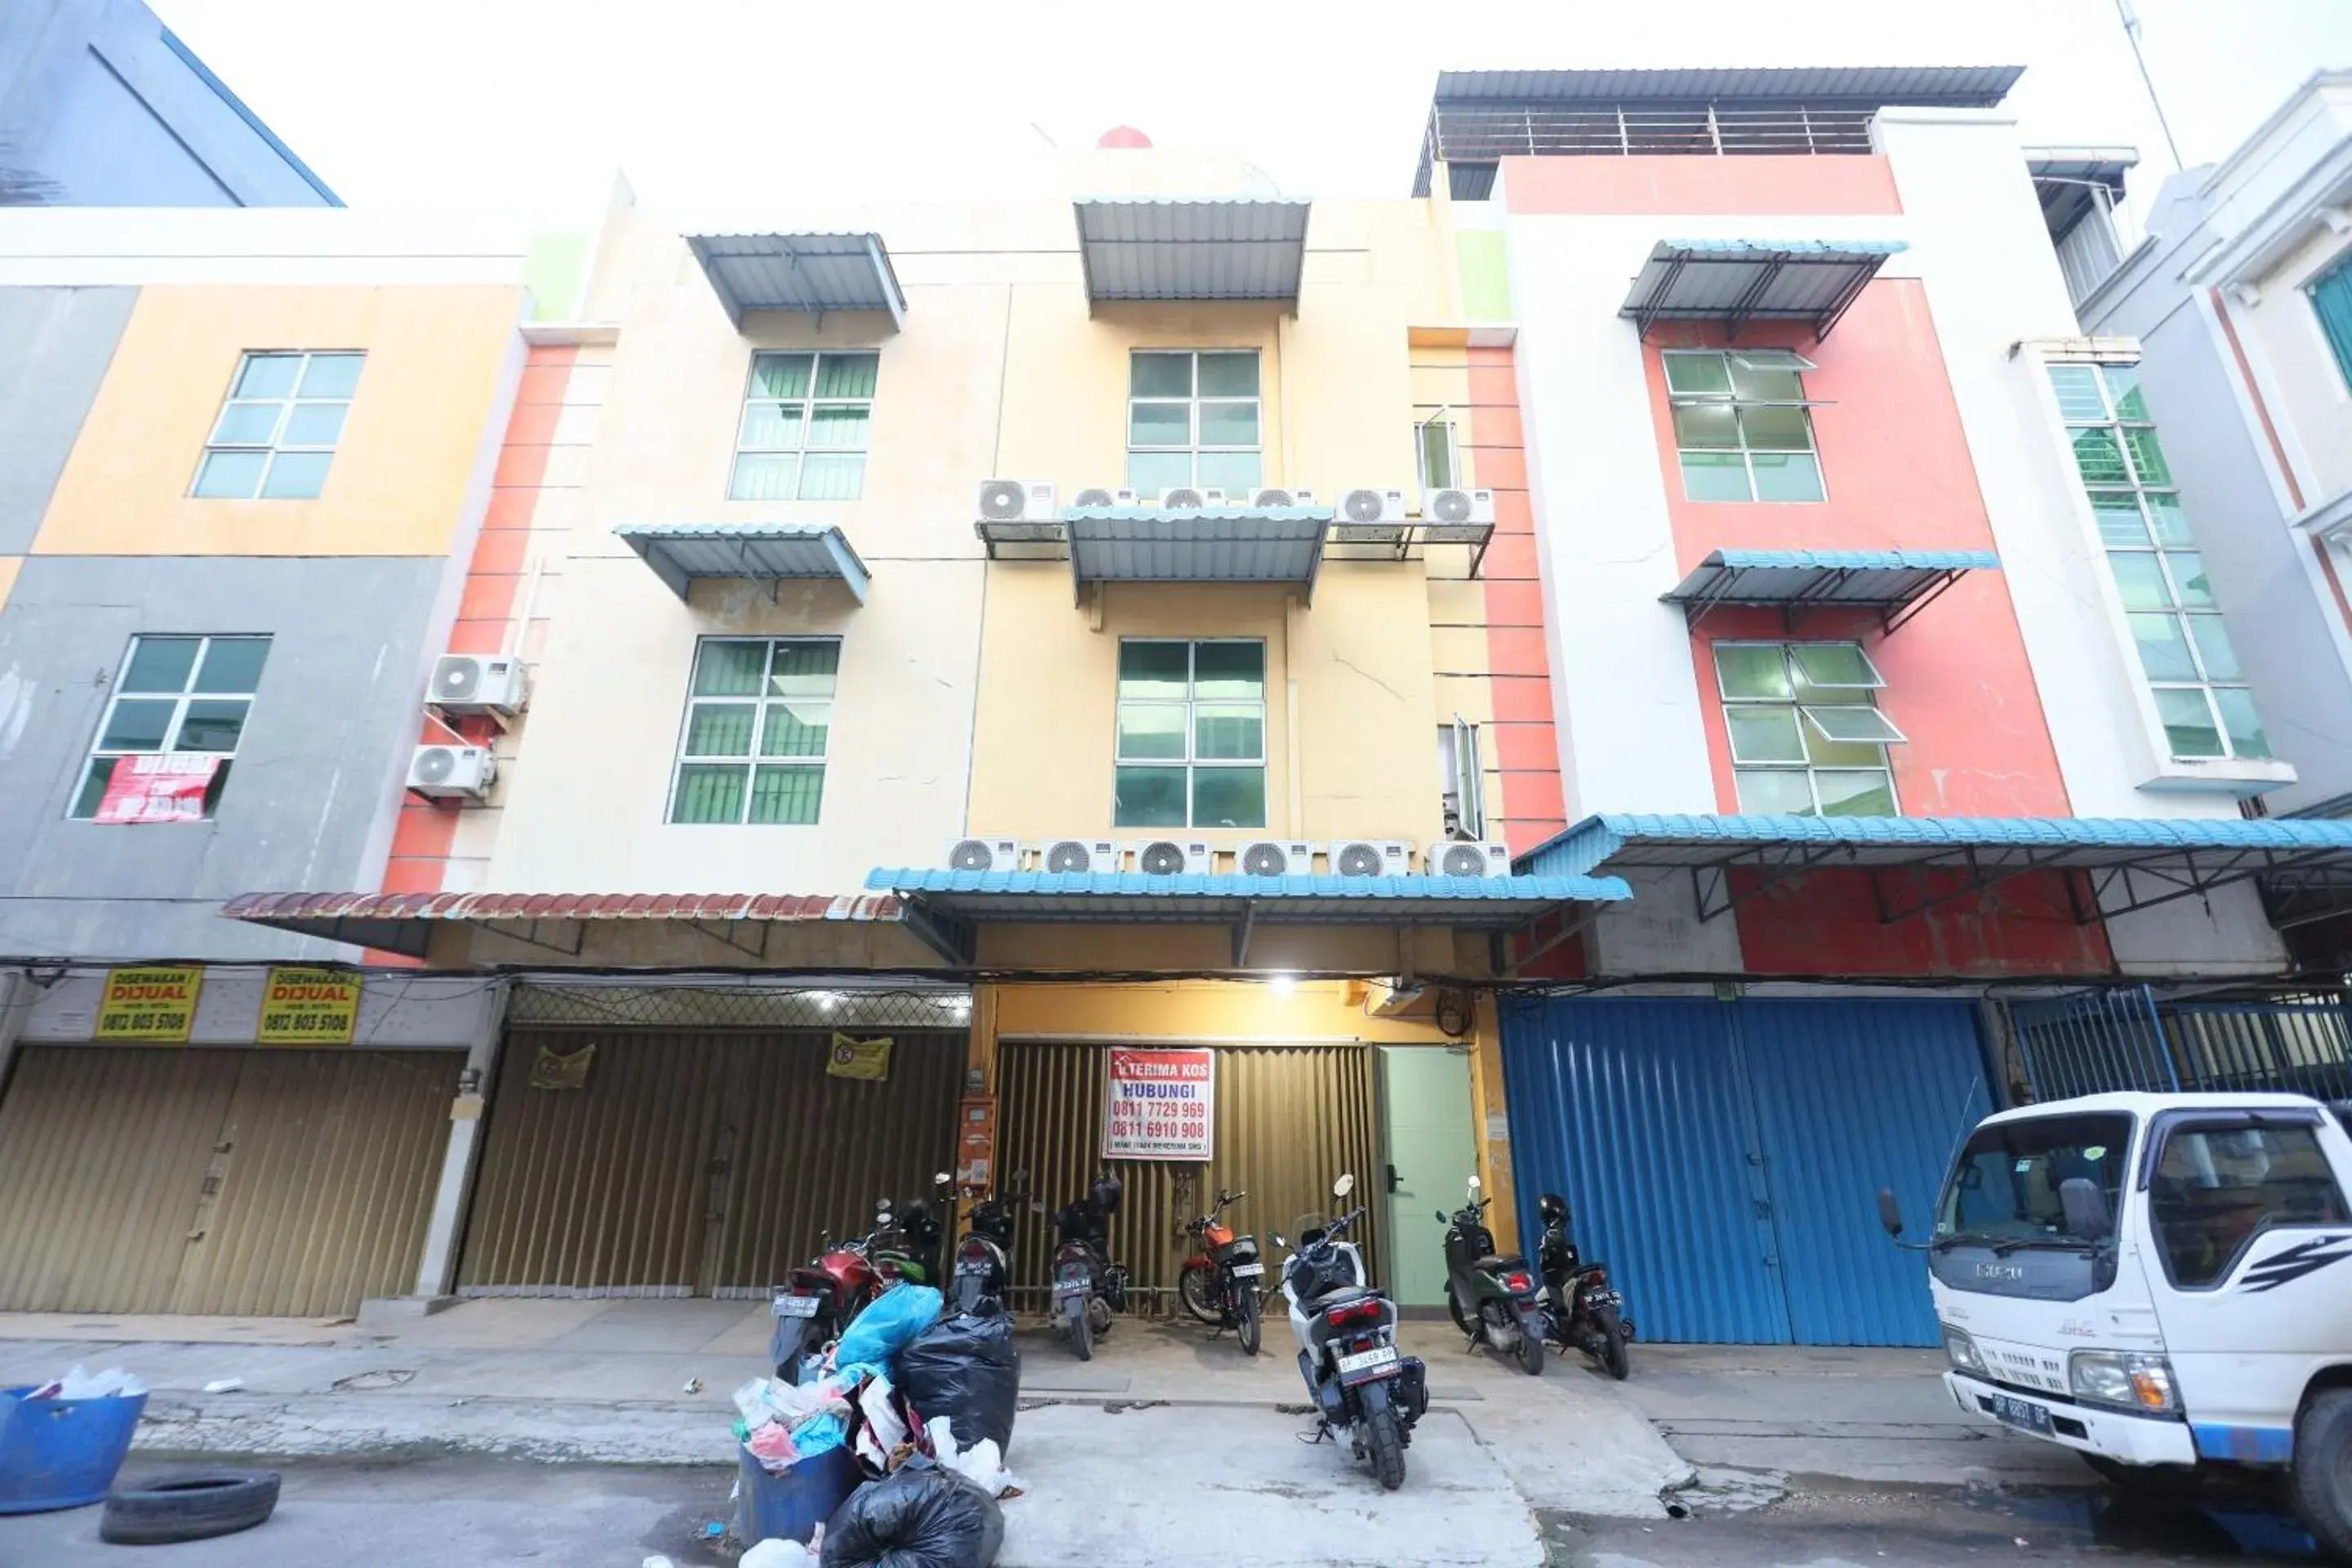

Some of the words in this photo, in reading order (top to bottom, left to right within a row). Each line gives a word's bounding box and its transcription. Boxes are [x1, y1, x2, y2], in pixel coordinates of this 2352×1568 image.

[111, 986, 188, 1001] DIJUAL
[271, 986, 350, 1001] DIJUAL
[1129, 1062, 1178, 1076] TERIMA
[1182, 1063, 1208, 1077] KOS
[1123, 1083, 1196, 1098] HUBUNGI
[1113, 1101, 1143, 1116] 0811
[1148, 1102, 1178, 1118] 7729
[1181, 1102, 1205, 1118] 969
[1112, 1120, 1143, 1138] 0811
[1147, 1121, 1178, 1138] 6910
[1181, 1121, 1205, 1138] 908
